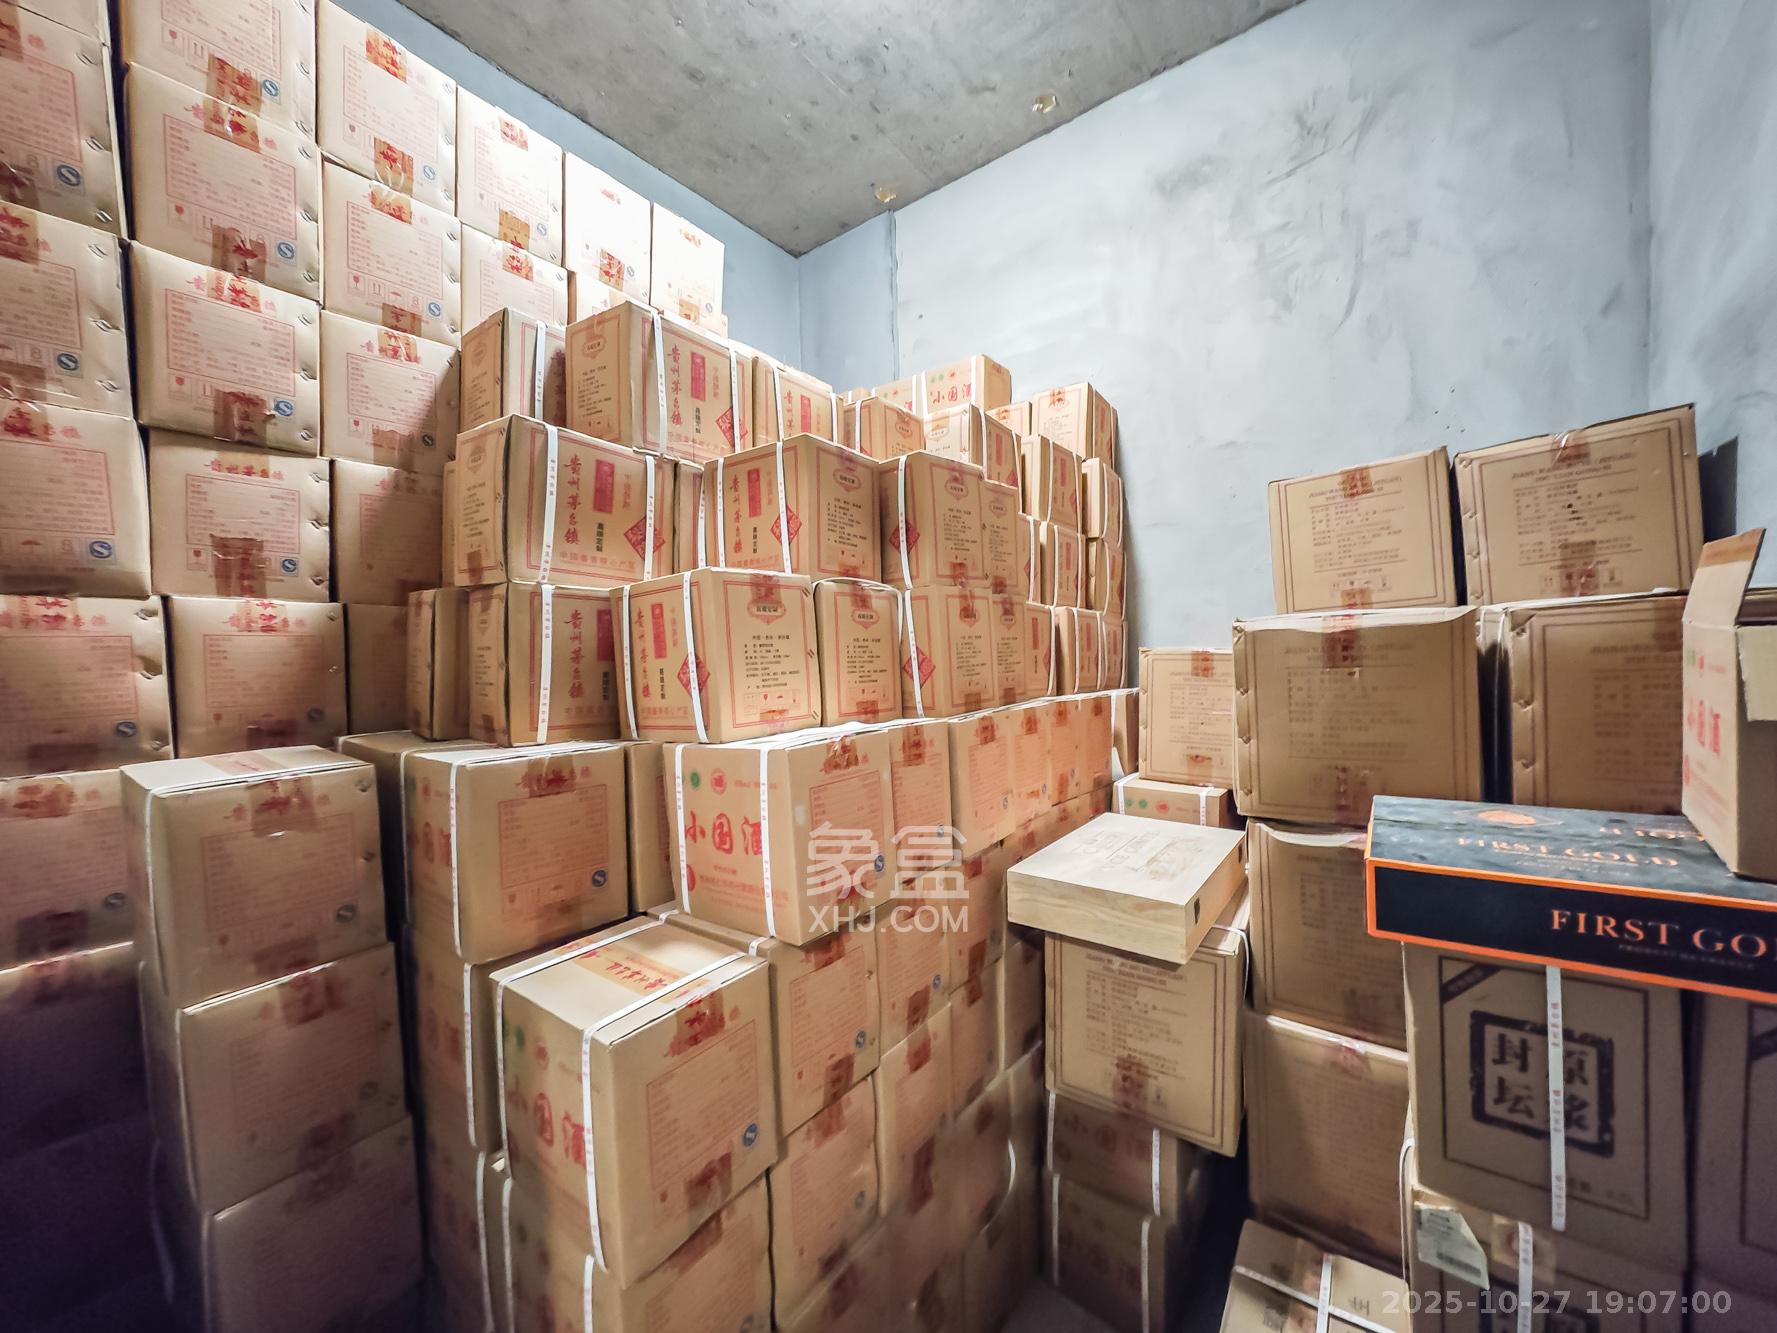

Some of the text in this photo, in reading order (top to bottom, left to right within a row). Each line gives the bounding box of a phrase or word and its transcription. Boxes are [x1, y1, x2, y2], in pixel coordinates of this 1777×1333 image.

[667, 344, 682, 426] 贵州茅台镇
[563, 453, 583, 545] 贵州茅台镇
[730, 474, 743, 554] 贵州茅台镇
[564, 608, 585, 699] 贵州茅台镇
[634, 607, 651, 699] 贵州茅台镇
[1551, 909, 1777, 958] FIRST GO
[1493, 1033, 1534, 1120] 封坛
